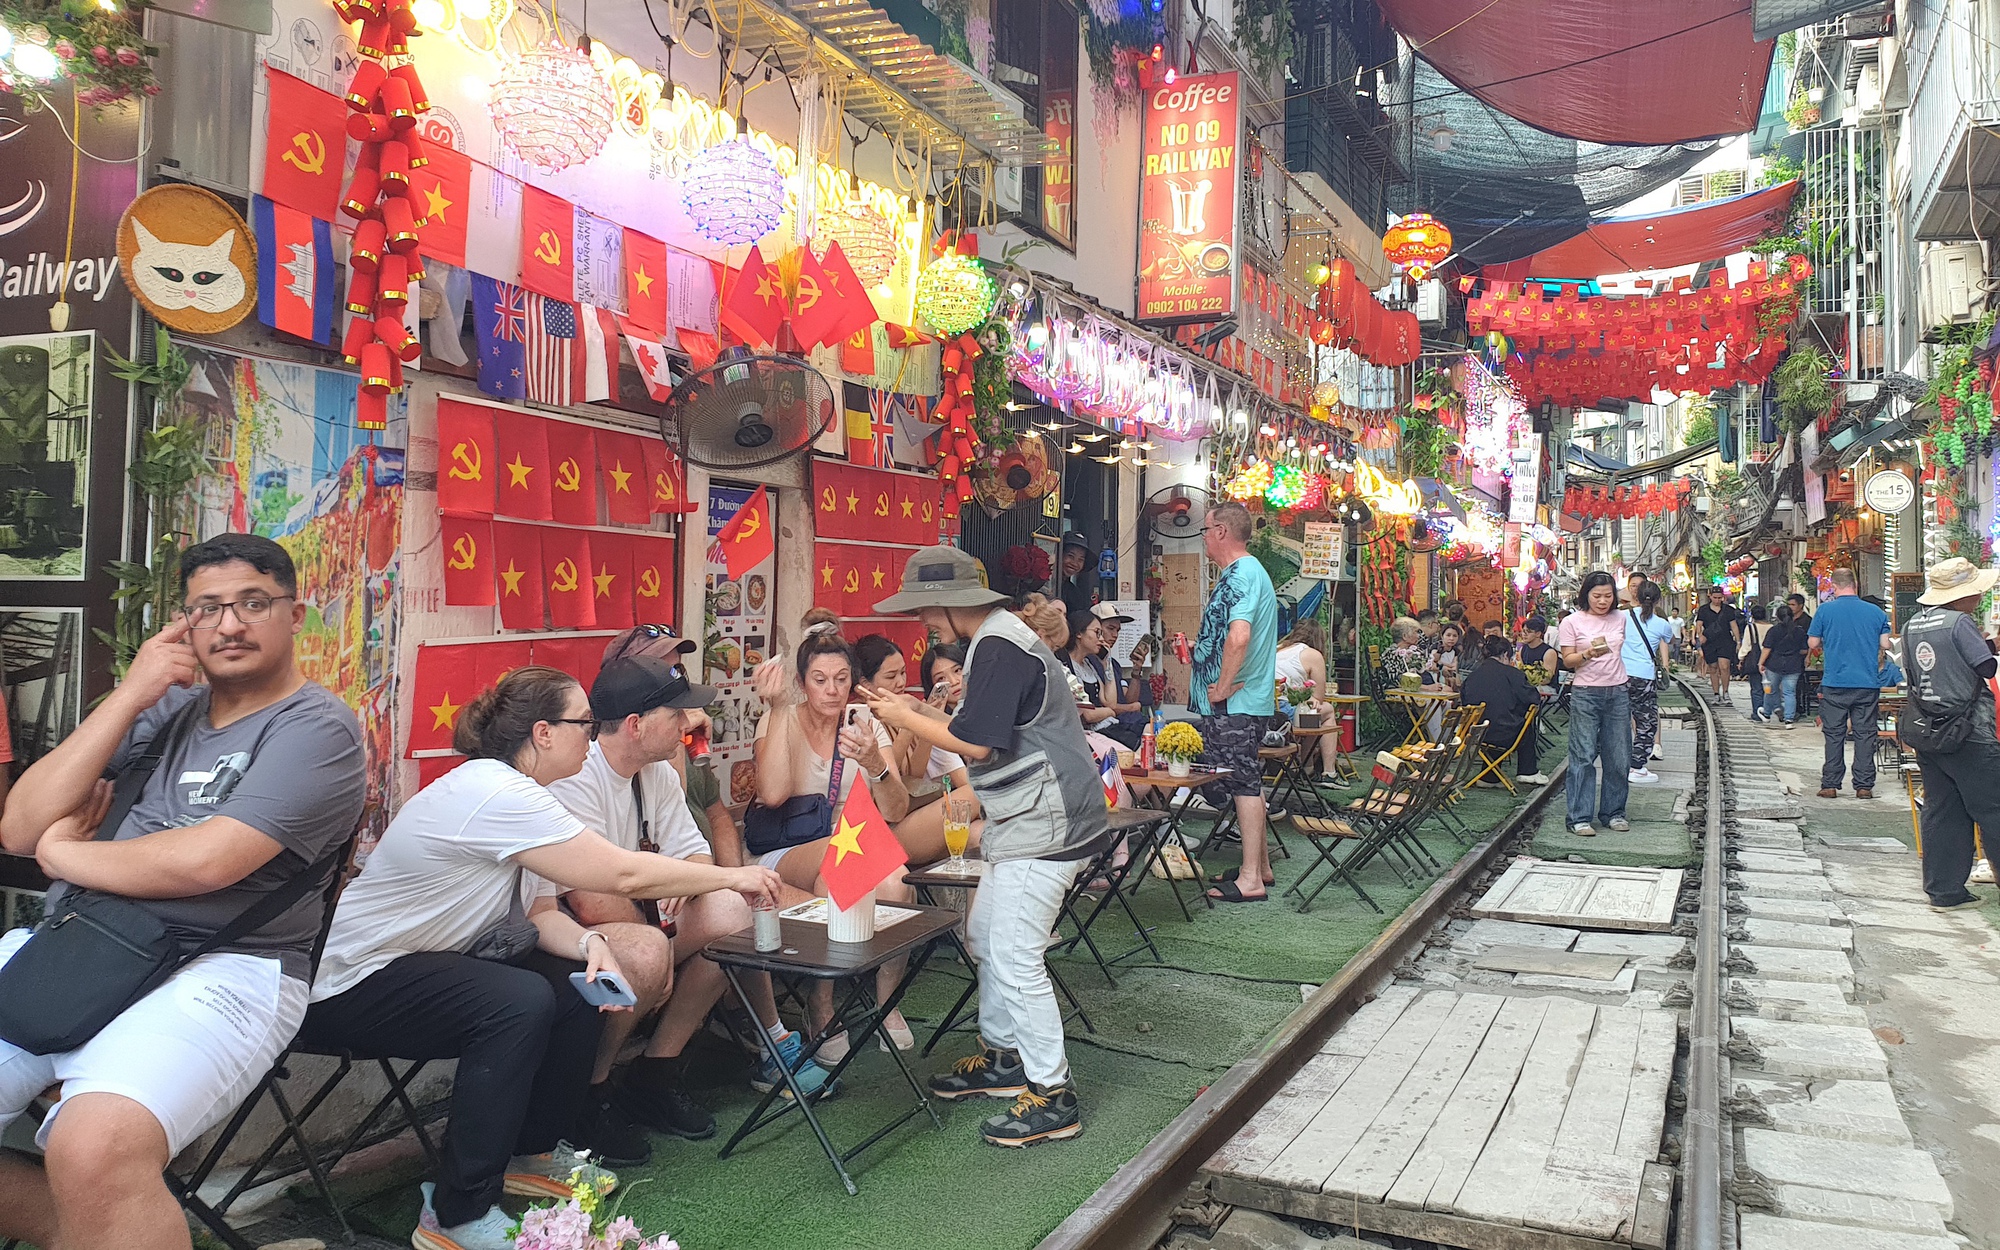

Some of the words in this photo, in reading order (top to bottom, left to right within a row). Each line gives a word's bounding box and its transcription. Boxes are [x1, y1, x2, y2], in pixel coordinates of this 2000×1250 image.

[1153, 83, 1232, 113] Coffee
[1161, 123, 1189, 147] NO
[1195, 119, 1220, 143] 09
[1146, 146, 1233, 176] RAILWAY
[576, 246, 583, 262] PC
[0, 252, 119, 302] ailway
[1163, 283, 1207, 297] Mobile:
[1147, 300, 1175, 314] 0902
[1178, 299, 1198, 312] 104
[1201, 297, 1223, 311] 222
[1889, 485, 1904, 495] 15
[1048, 497, 1054, 512] 9
[1523, 495, 1534, 503] 06
[831, 760, 843, 787] MARY
[188, 796, 219, 805] MOMENT
